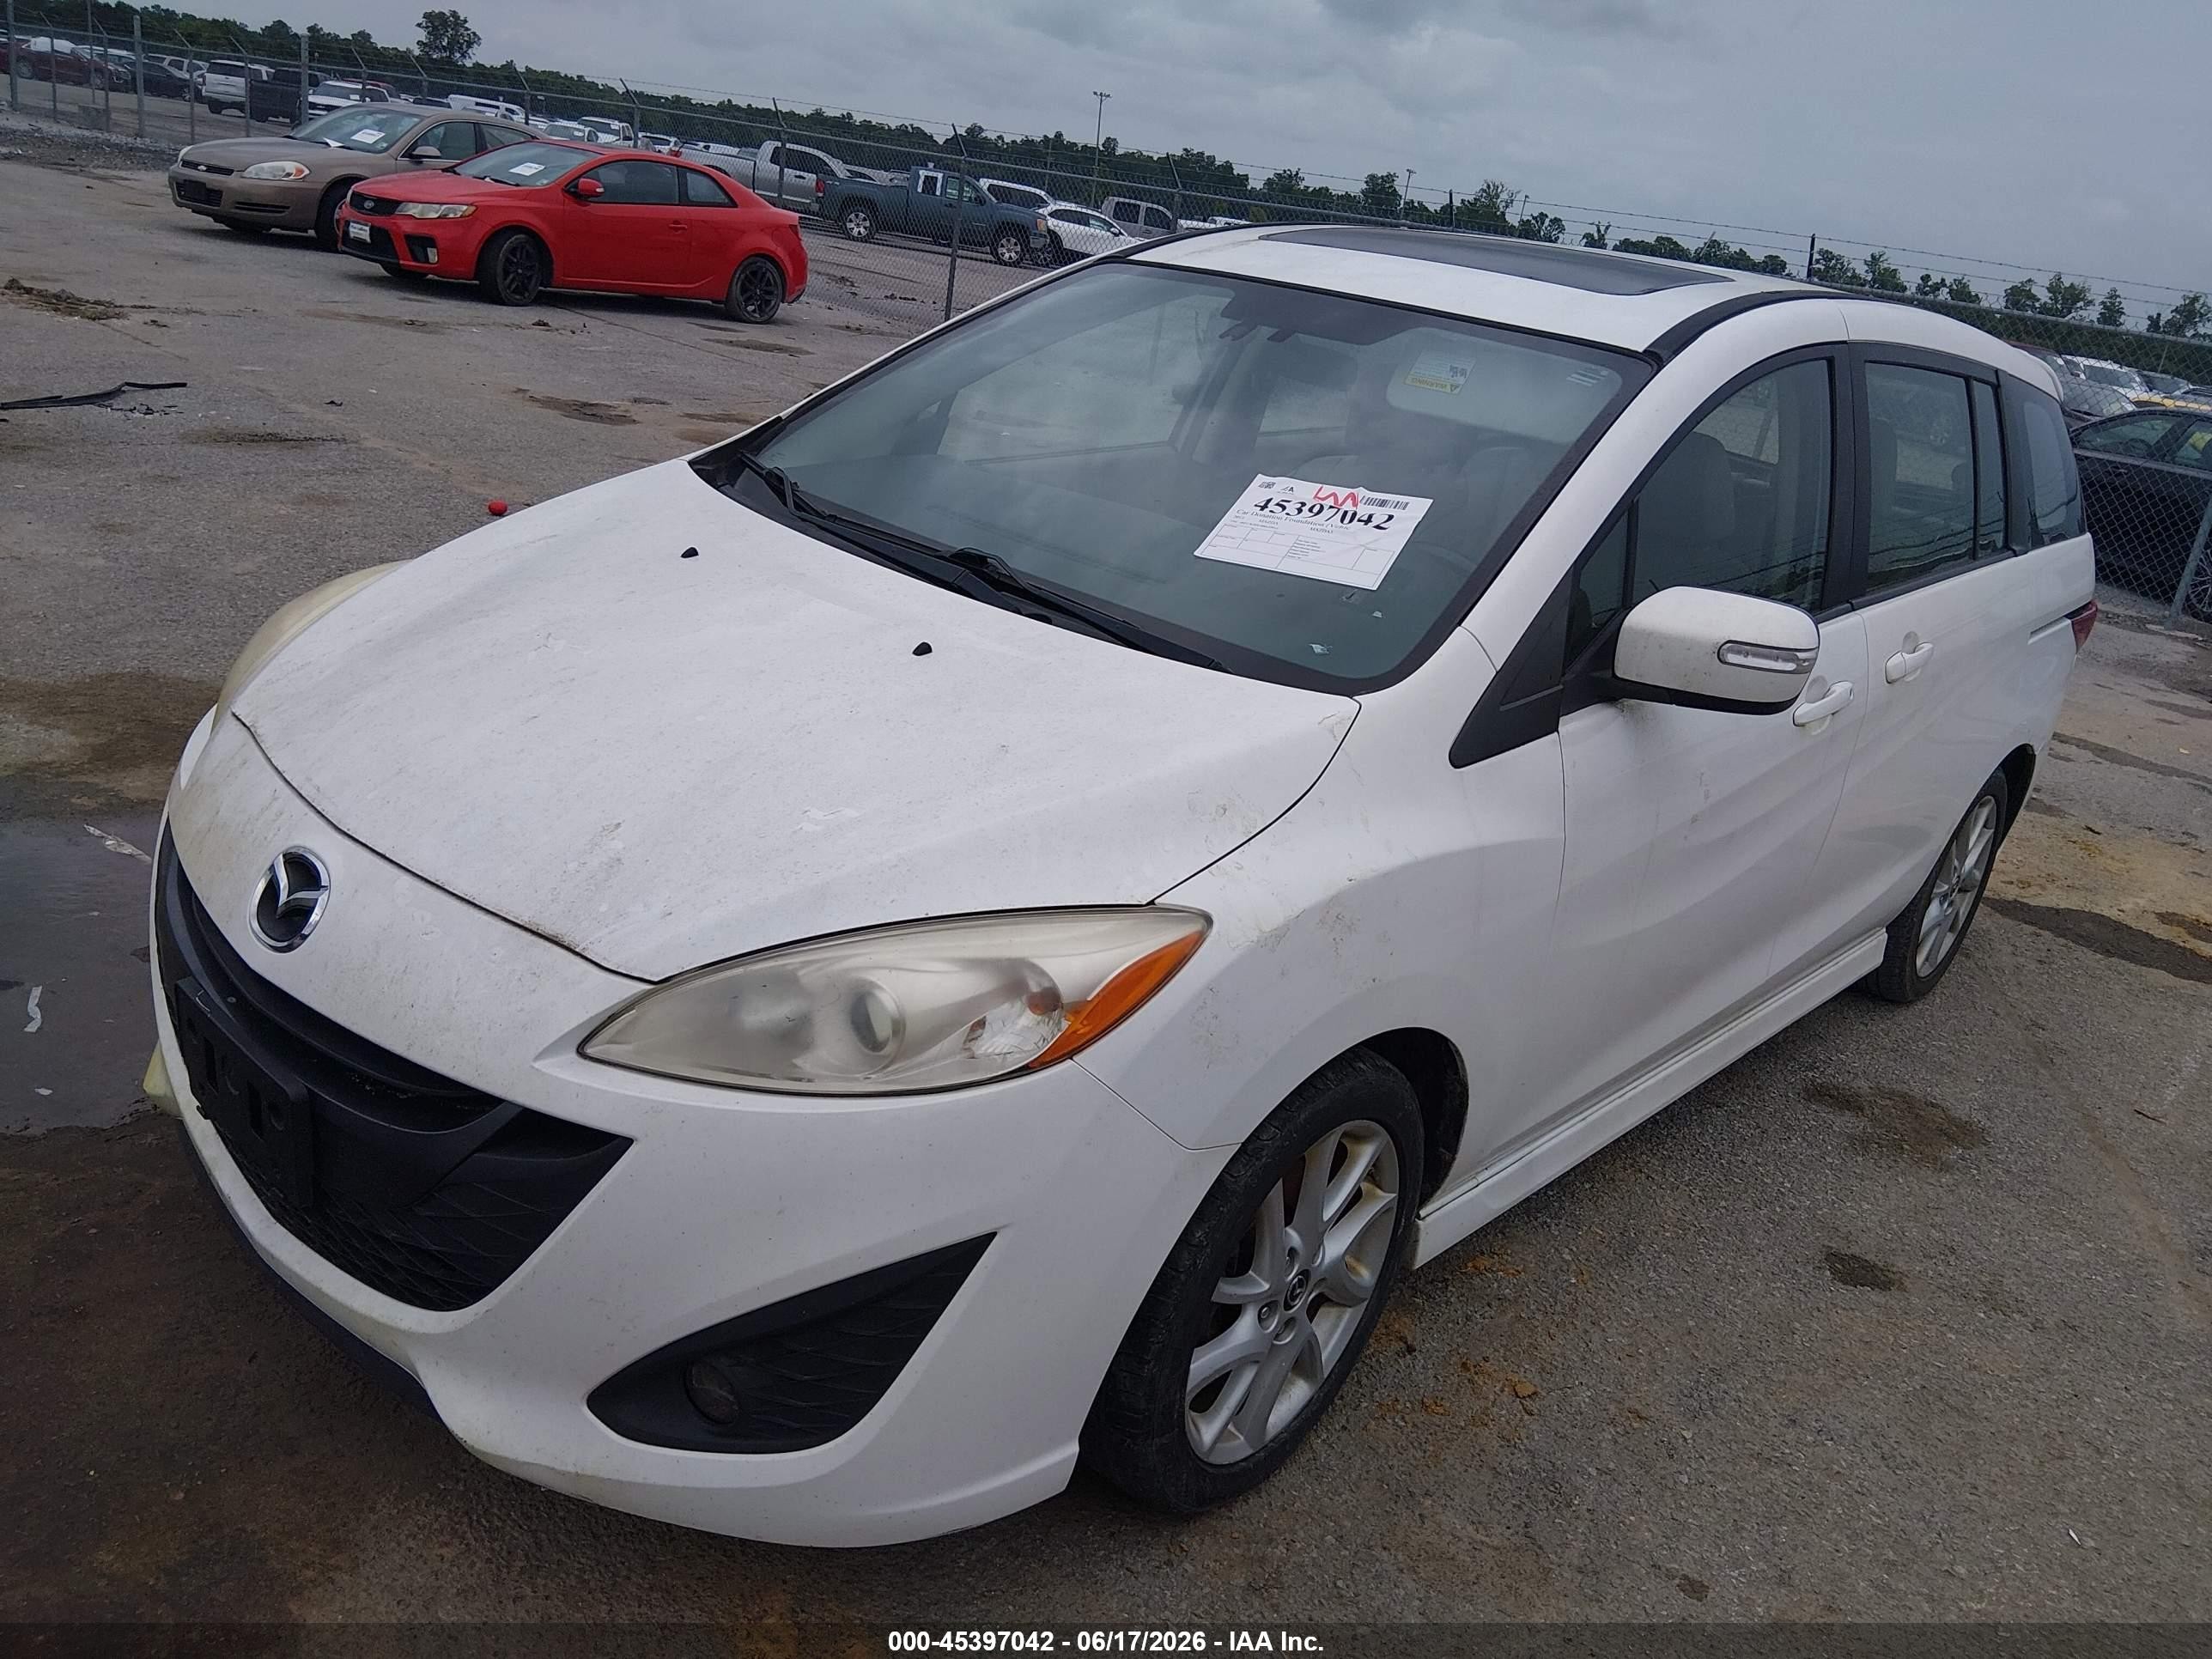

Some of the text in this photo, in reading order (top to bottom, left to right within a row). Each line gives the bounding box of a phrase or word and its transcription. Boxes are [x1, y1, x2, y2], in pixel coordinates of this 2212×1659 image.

[1250, 511, 1283, 521] Donation
[1284, 516, 1325, 528] Foundation
[1254, 497, 1395, 532] 45397042
